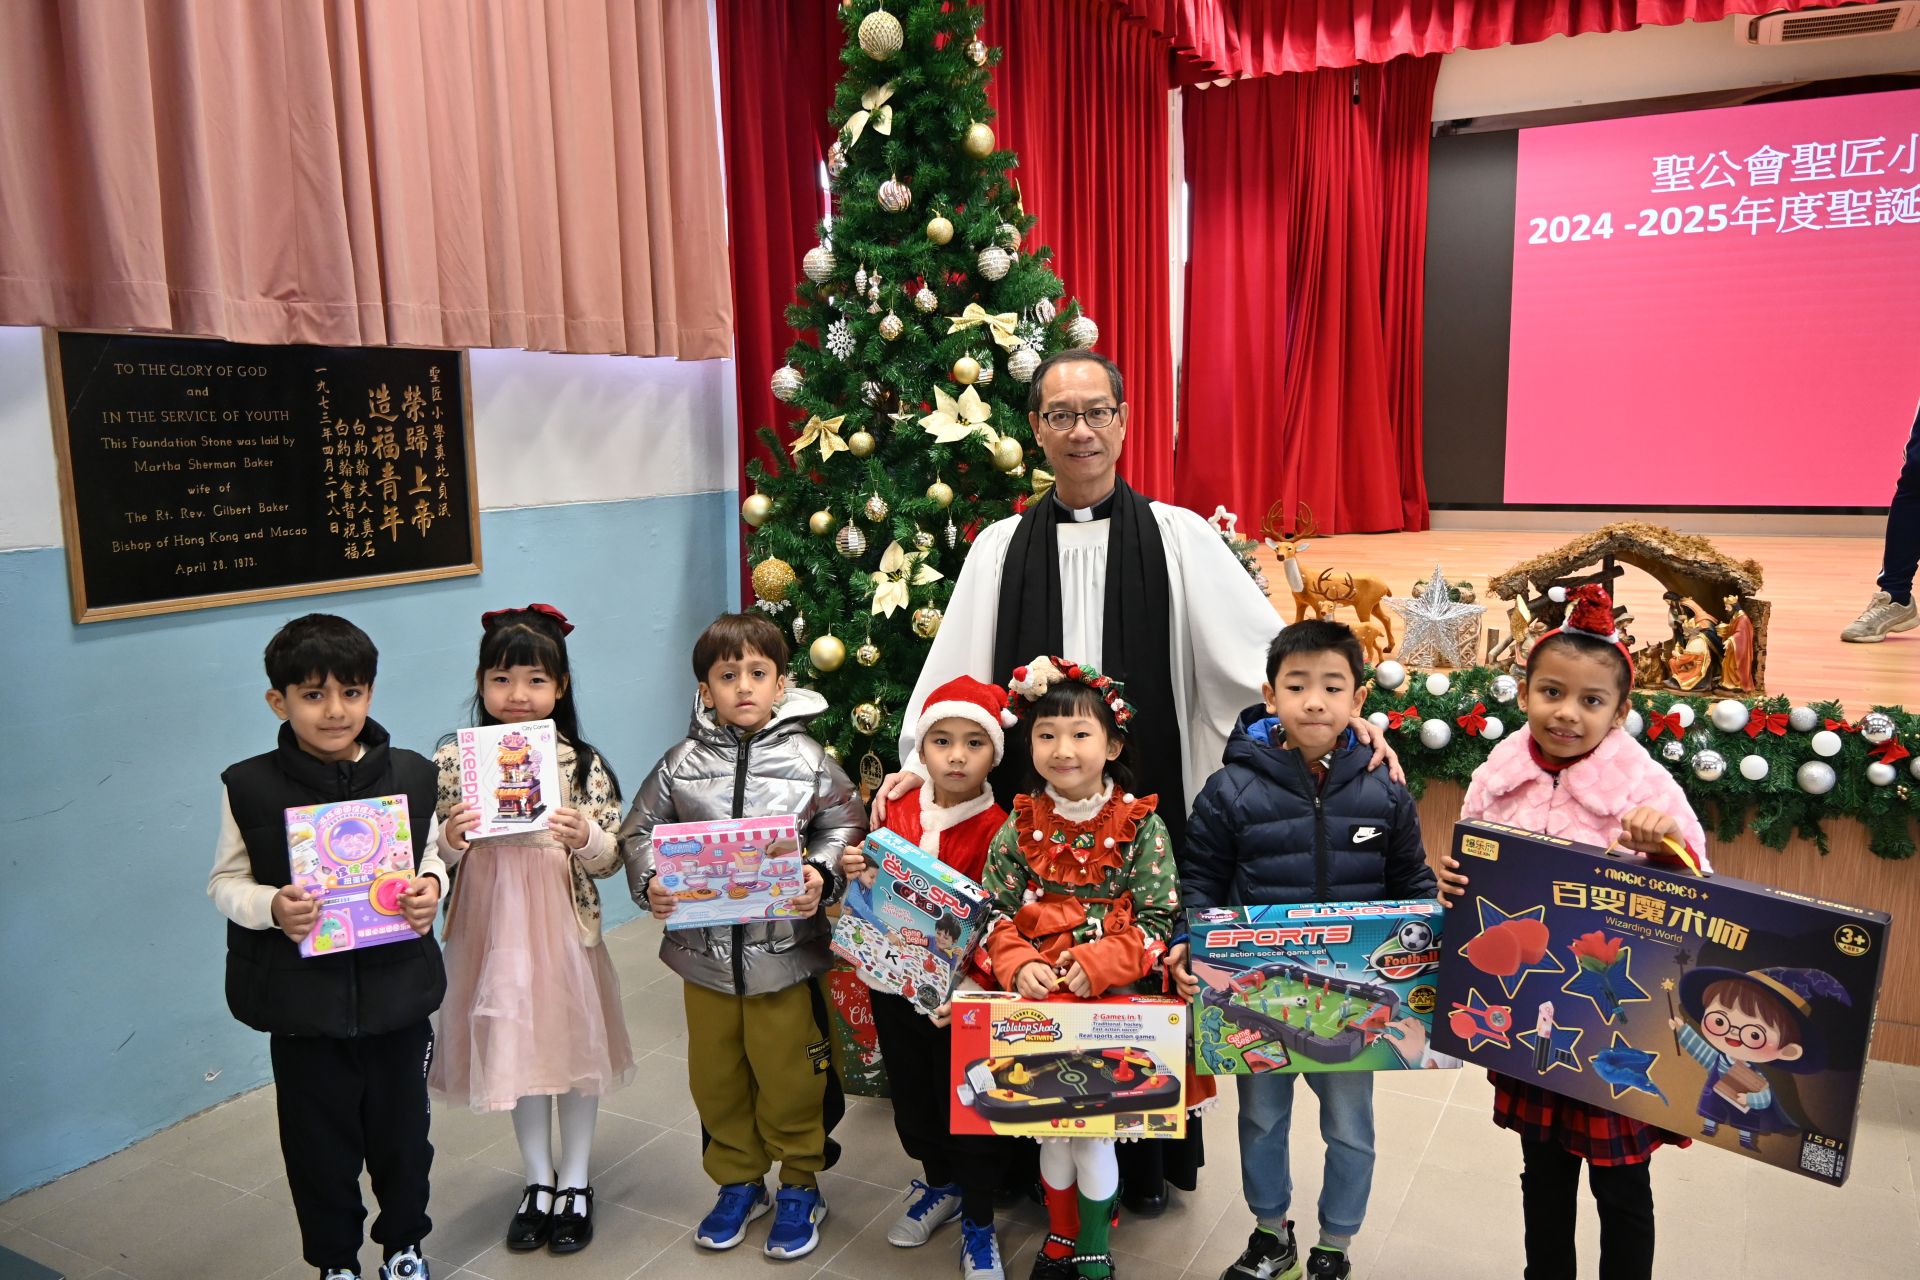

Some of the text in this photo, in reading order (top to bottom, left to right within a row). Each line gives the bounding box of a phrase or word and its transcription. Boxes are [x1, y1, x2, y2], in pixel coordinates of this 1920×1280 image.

[1528, 212, 1613, 244] 2024
[114, 363, 267, 377] TO THE GLORY OF GOD
[186, 387, 209, 397] and
[103, 410, 289, 424] IN THE SERVICE OF YOUTH
[100, 435, 296, 449] This Foundation Stone was laid by
[314, 367, 340, 534] 一九七三年四月二十八日
[134, 457, 274, 473] Martha Sherman Baker
[368, 382, 404, 542] 造福青年
[402, 385, 435, 538] 榮歸上帝
[188, 482, 232, 495] wife of
[125, 502, 290, 524] The Rt. Rev. Gilbert Baker
[112, 526, 308, 553] Bishop of Hong Kong and Macao
[175, 562, 206, 576] April
[1605, 868, 1697, 900] MAGIC SERIES
[1552, 881, 1750, 951] 百变魔术师
[1205, 925, 1353, 948] SPORTS
[1605, 916, 1683, 943] Wizarding World
[1841, 928, 1866, 946] 3+
[1384, 950, 1439, 967] Football
[1409, 996, 1434, 1004] GAM
[992, 1020, 1032, 1038] Tabletop
